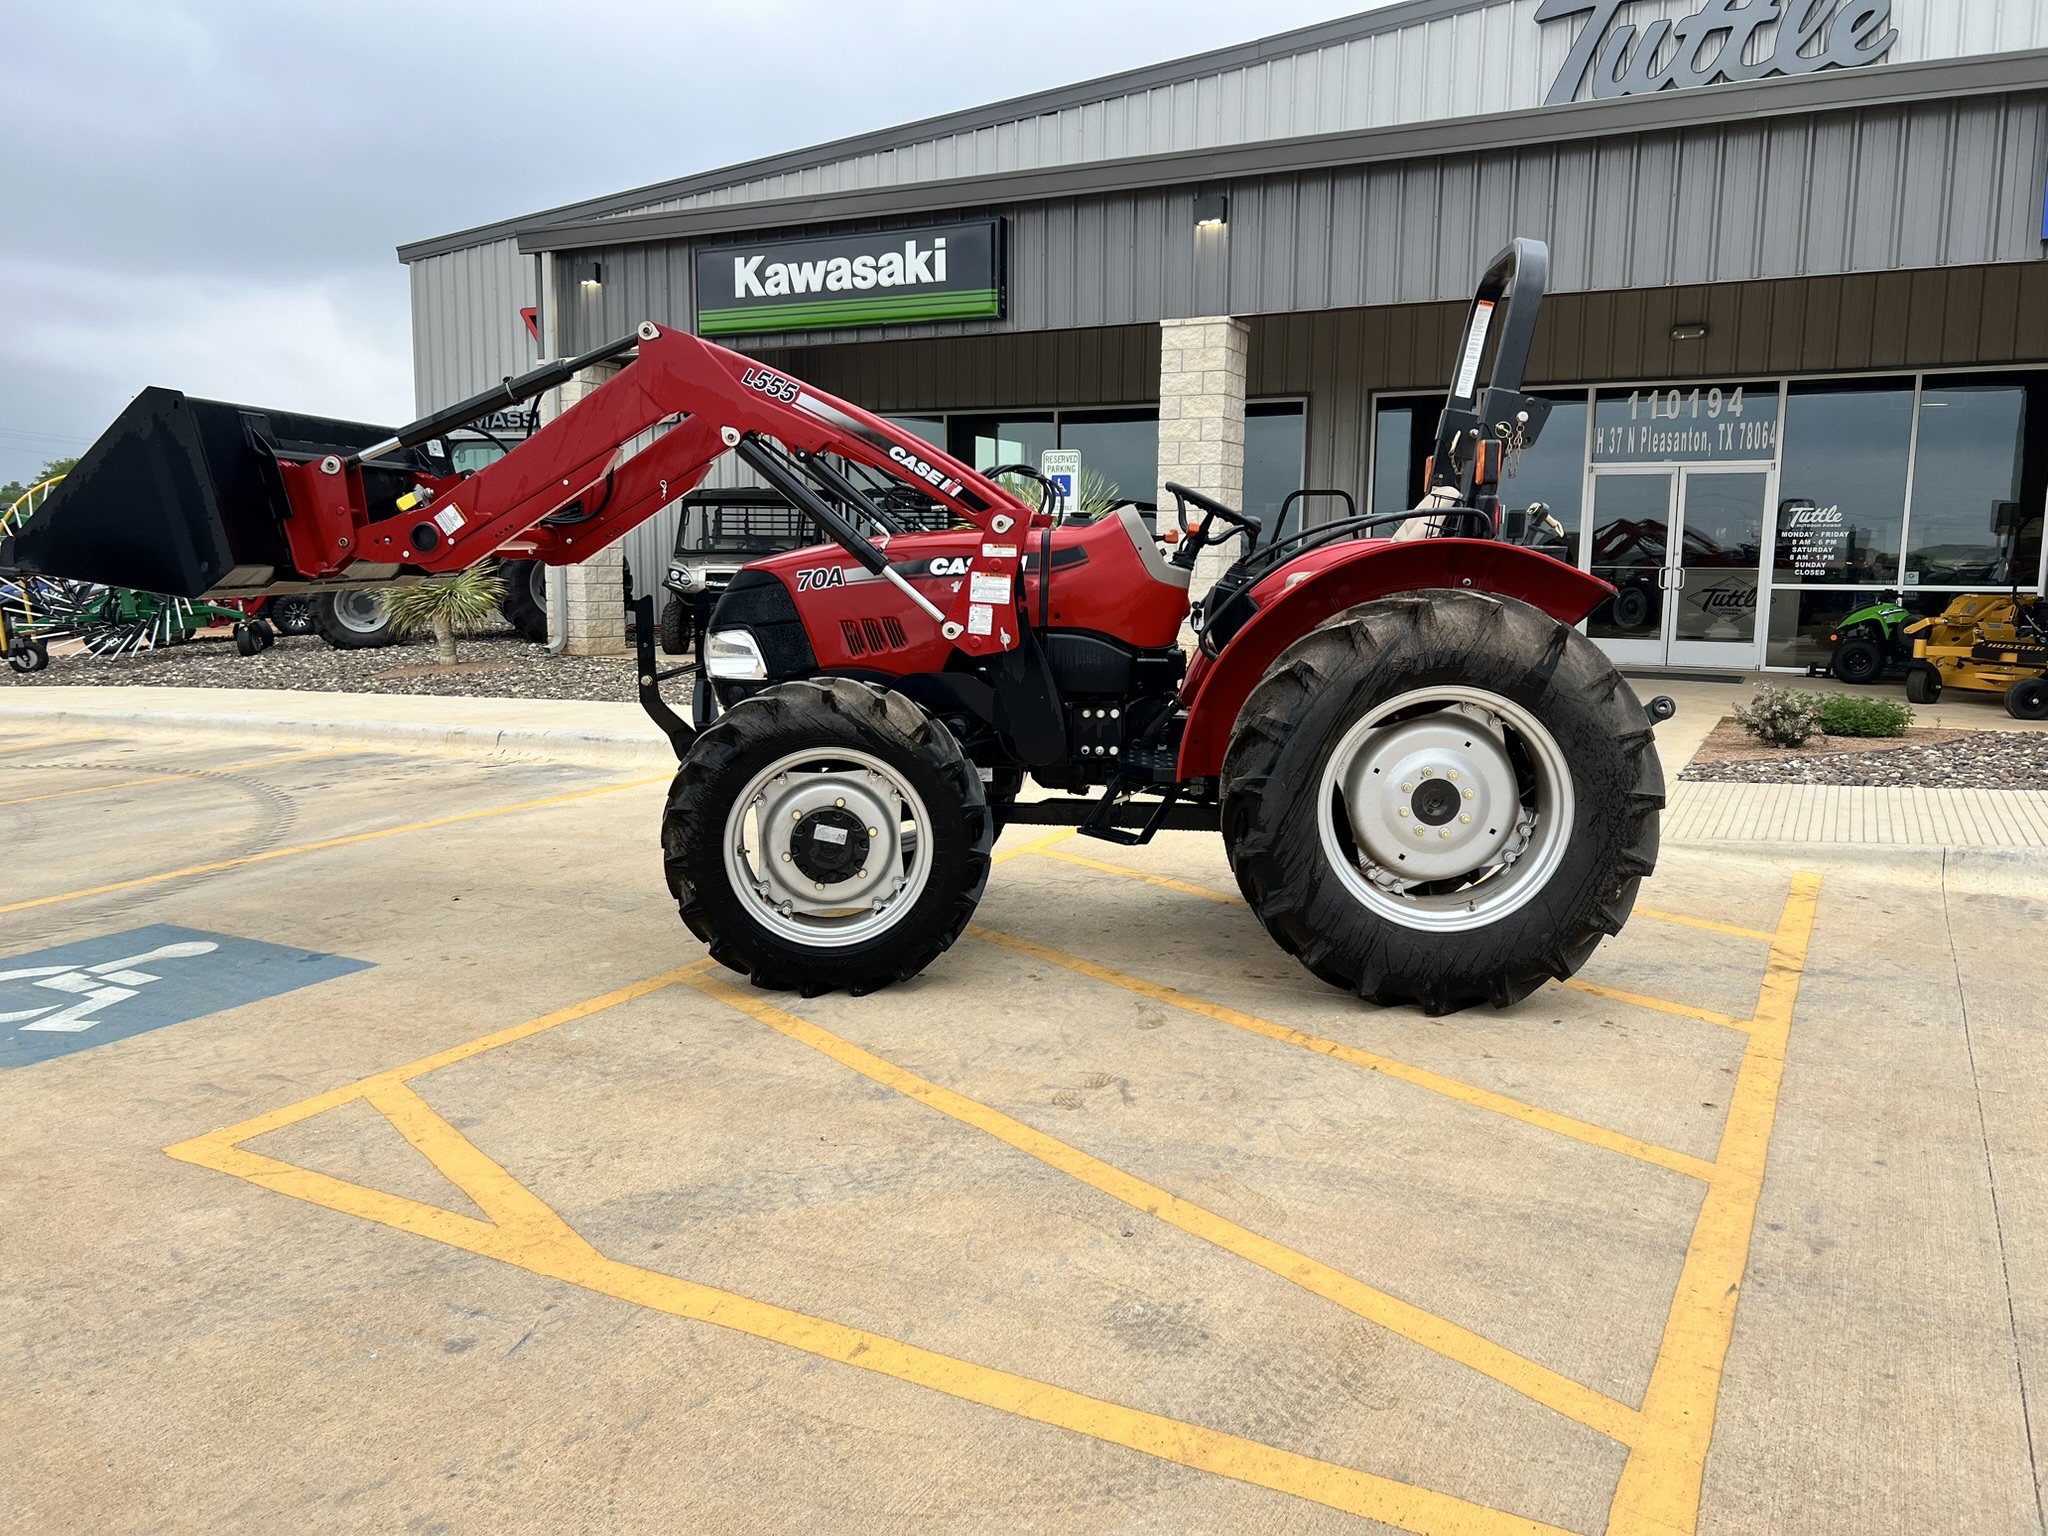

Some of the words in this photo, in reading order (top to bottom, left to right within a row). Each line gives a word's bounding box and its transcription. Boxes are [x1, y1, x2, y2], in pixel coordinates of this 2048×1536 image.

[1534, 0, 1899, 106] Tuttle
[733, 237, 947, 298] Kawasaki
[741, 367, 800, 403] L555
[1627, 387, 1743, 420] 110194
[1609, 426, 1623, 454] 37
[1627, 426, 1636, 453] N
[1640, 425, 1712, 457] Pleasanton,
[1718, 422, 1734, 451] TX
[1739, 420, 1776, 450] 78064
[889, 446, 945, 486] CASE
[1045, 455, 1078, 464] RESERVED
[1047, 465, 1076, 473] PARKING
[1789, 504, 1843, 528] Tuttle
[796, 565, 845, 592] 70A
[1701, 587, 1757, 613] Tuttl
[1987, 642, 2046, 652] HUSTLER
